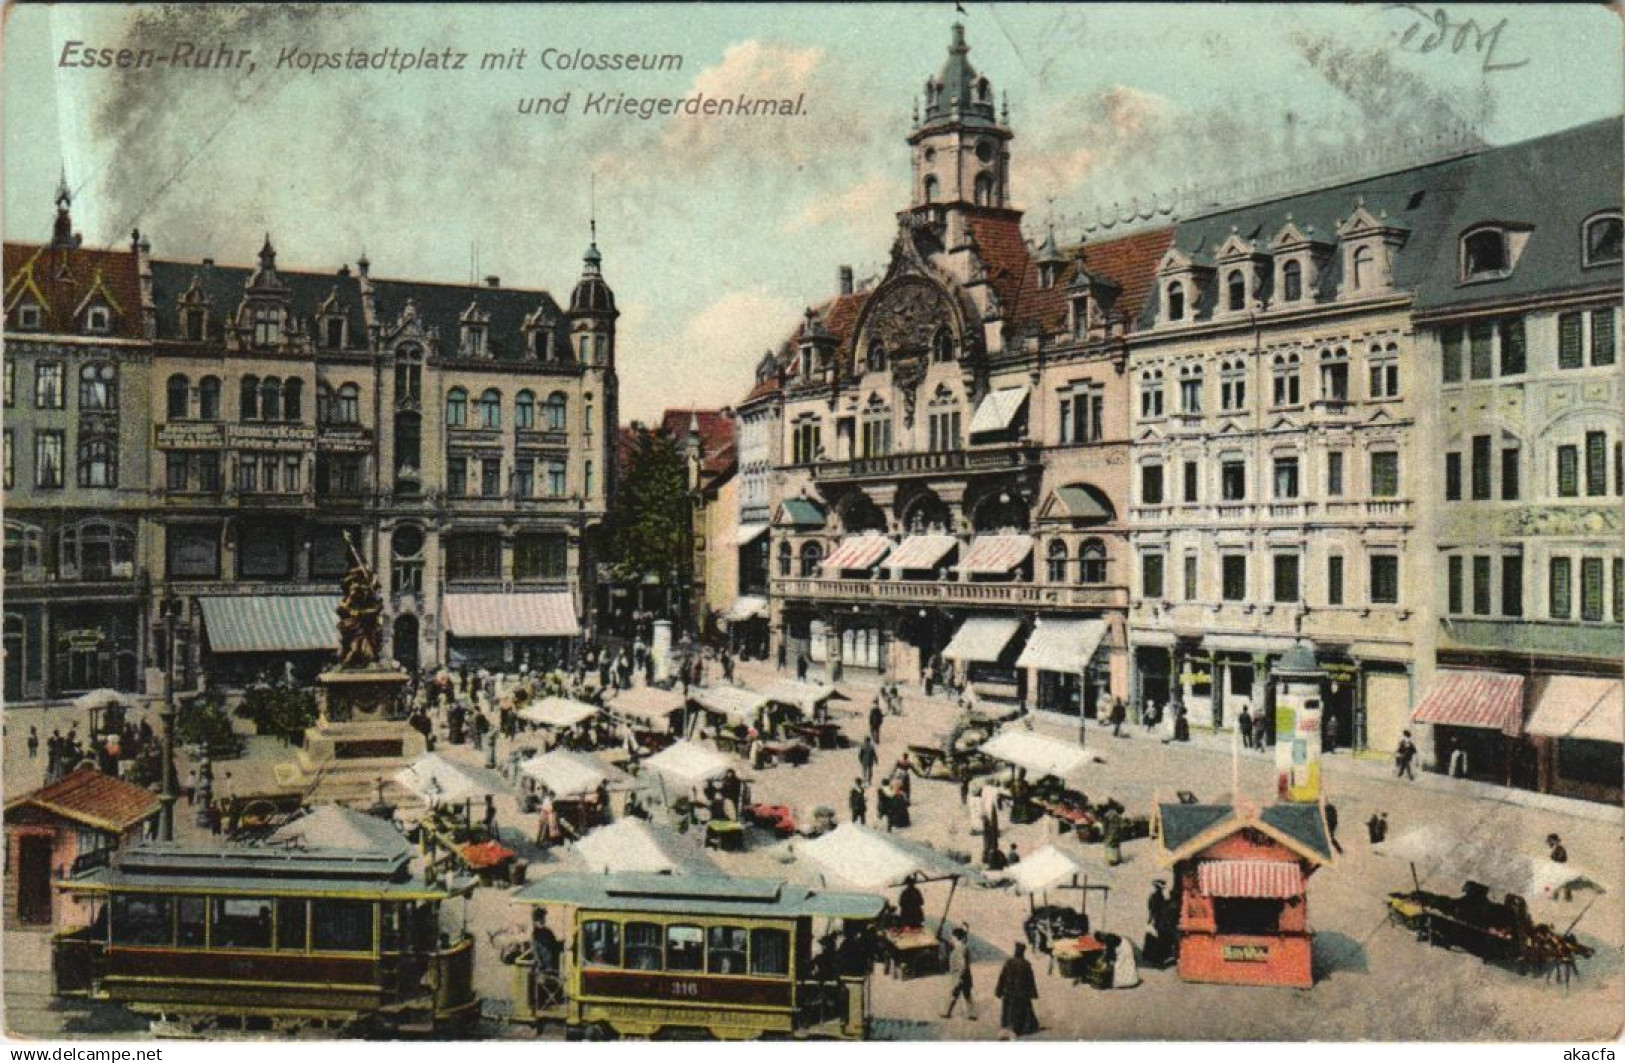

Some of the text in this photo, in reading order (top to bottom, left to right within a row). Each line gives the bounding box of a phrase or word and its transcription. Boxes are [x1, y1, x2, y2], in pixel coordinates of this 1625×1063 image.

[58, 40, 684, 74] Essen-Ruhr, Kopstadtplatz mit Colosseum
[517, 92, 808, 120] und Kriegerdenkmal.
